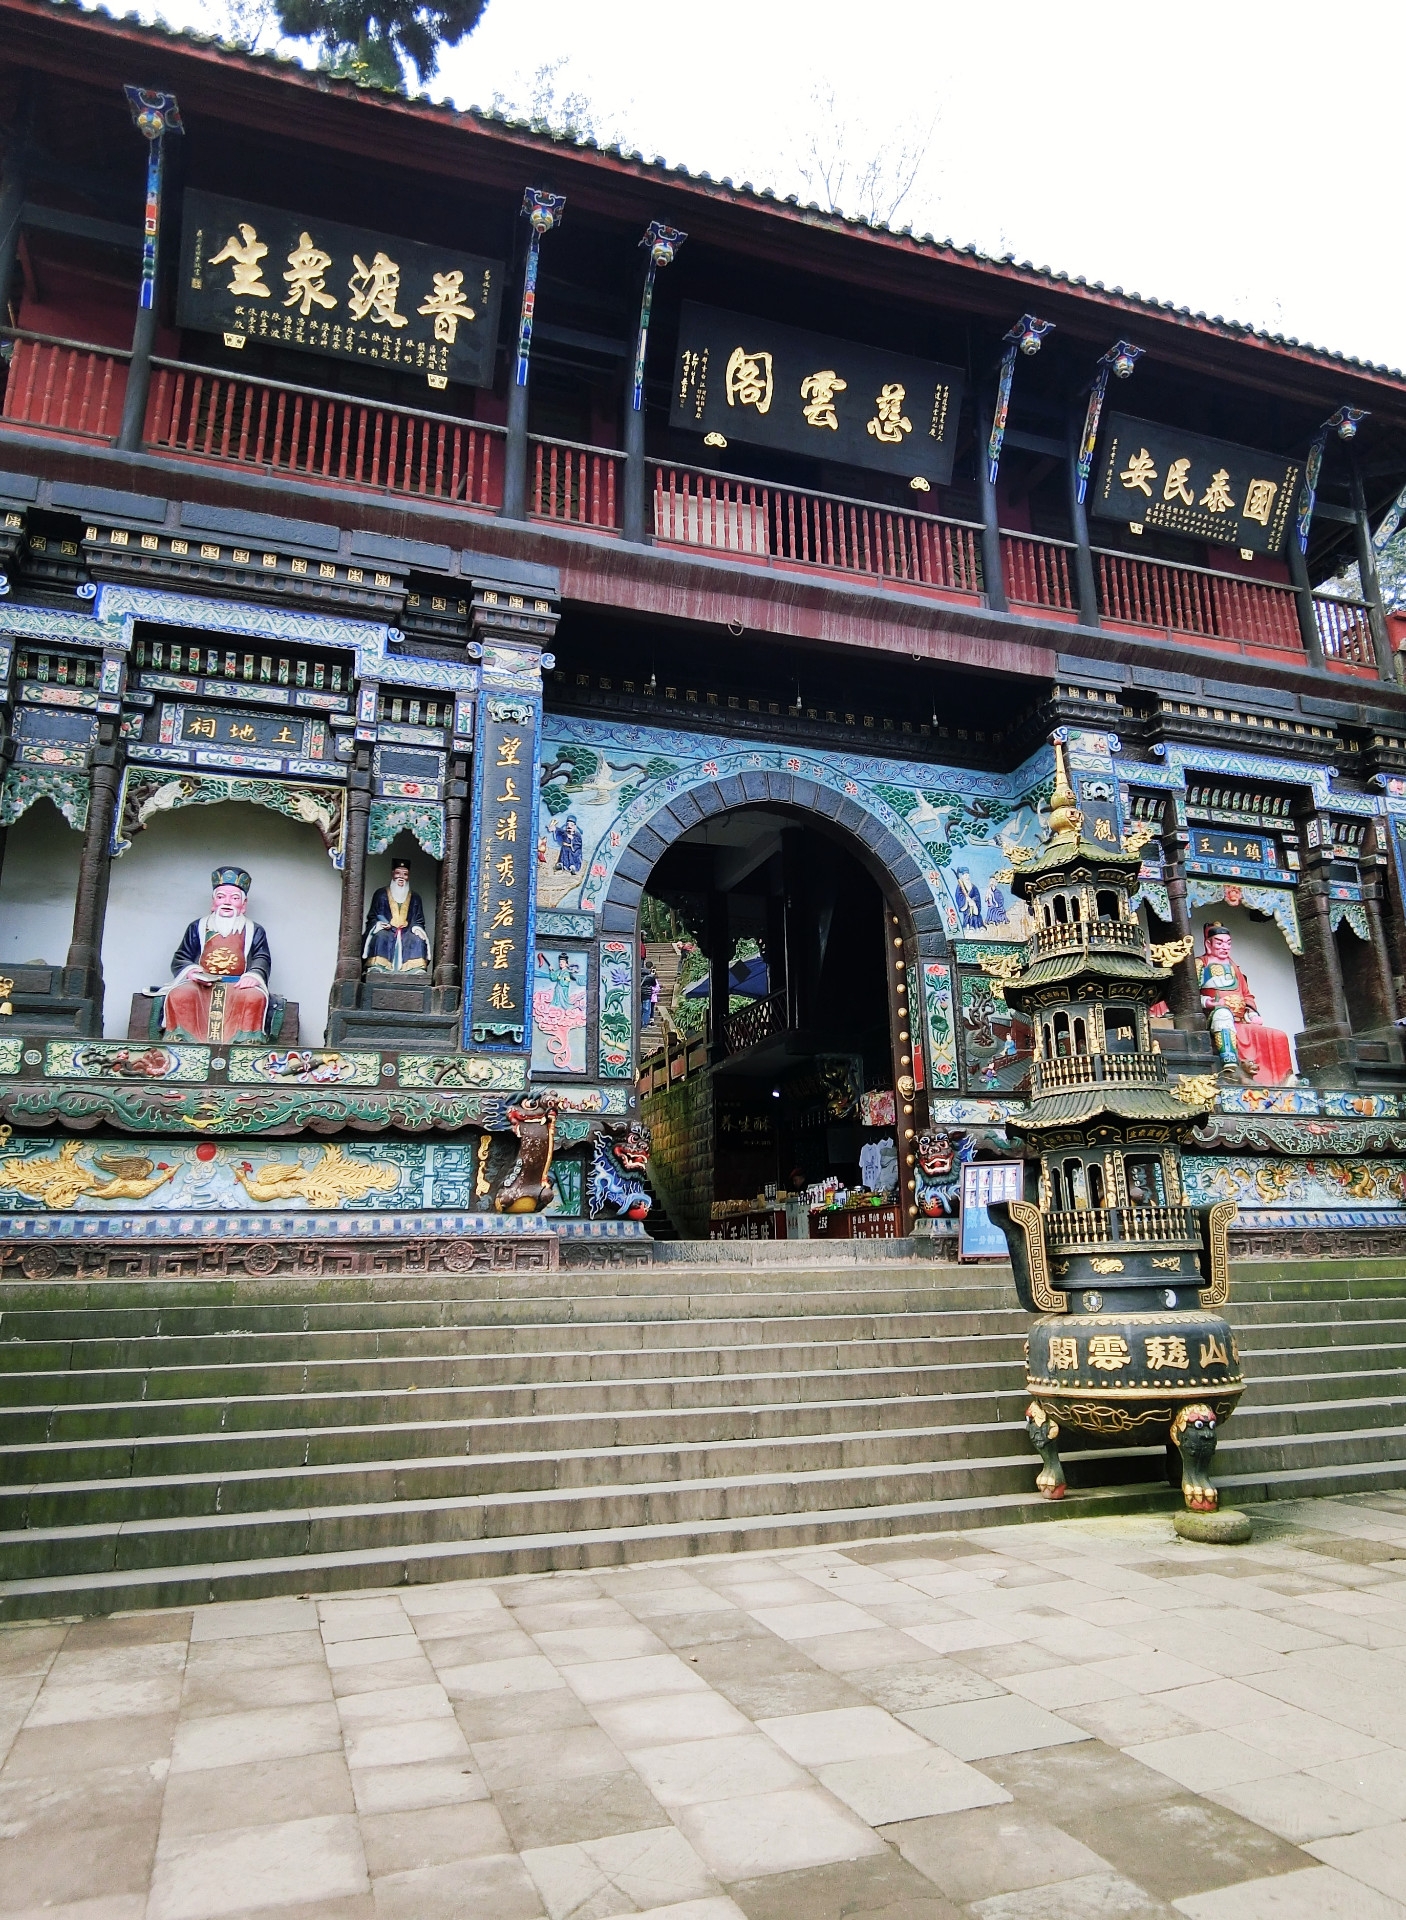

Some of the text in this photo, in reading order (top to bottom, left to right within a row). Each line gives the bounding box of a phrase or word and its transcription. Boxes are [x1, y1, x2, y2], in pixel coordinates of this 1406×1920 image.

[187, 714, 297, 745] 土地祠
[1199, 836, 1262, 862] 鎮山王
[1047, 1334, 1240, 1371] 山慈雲閣
